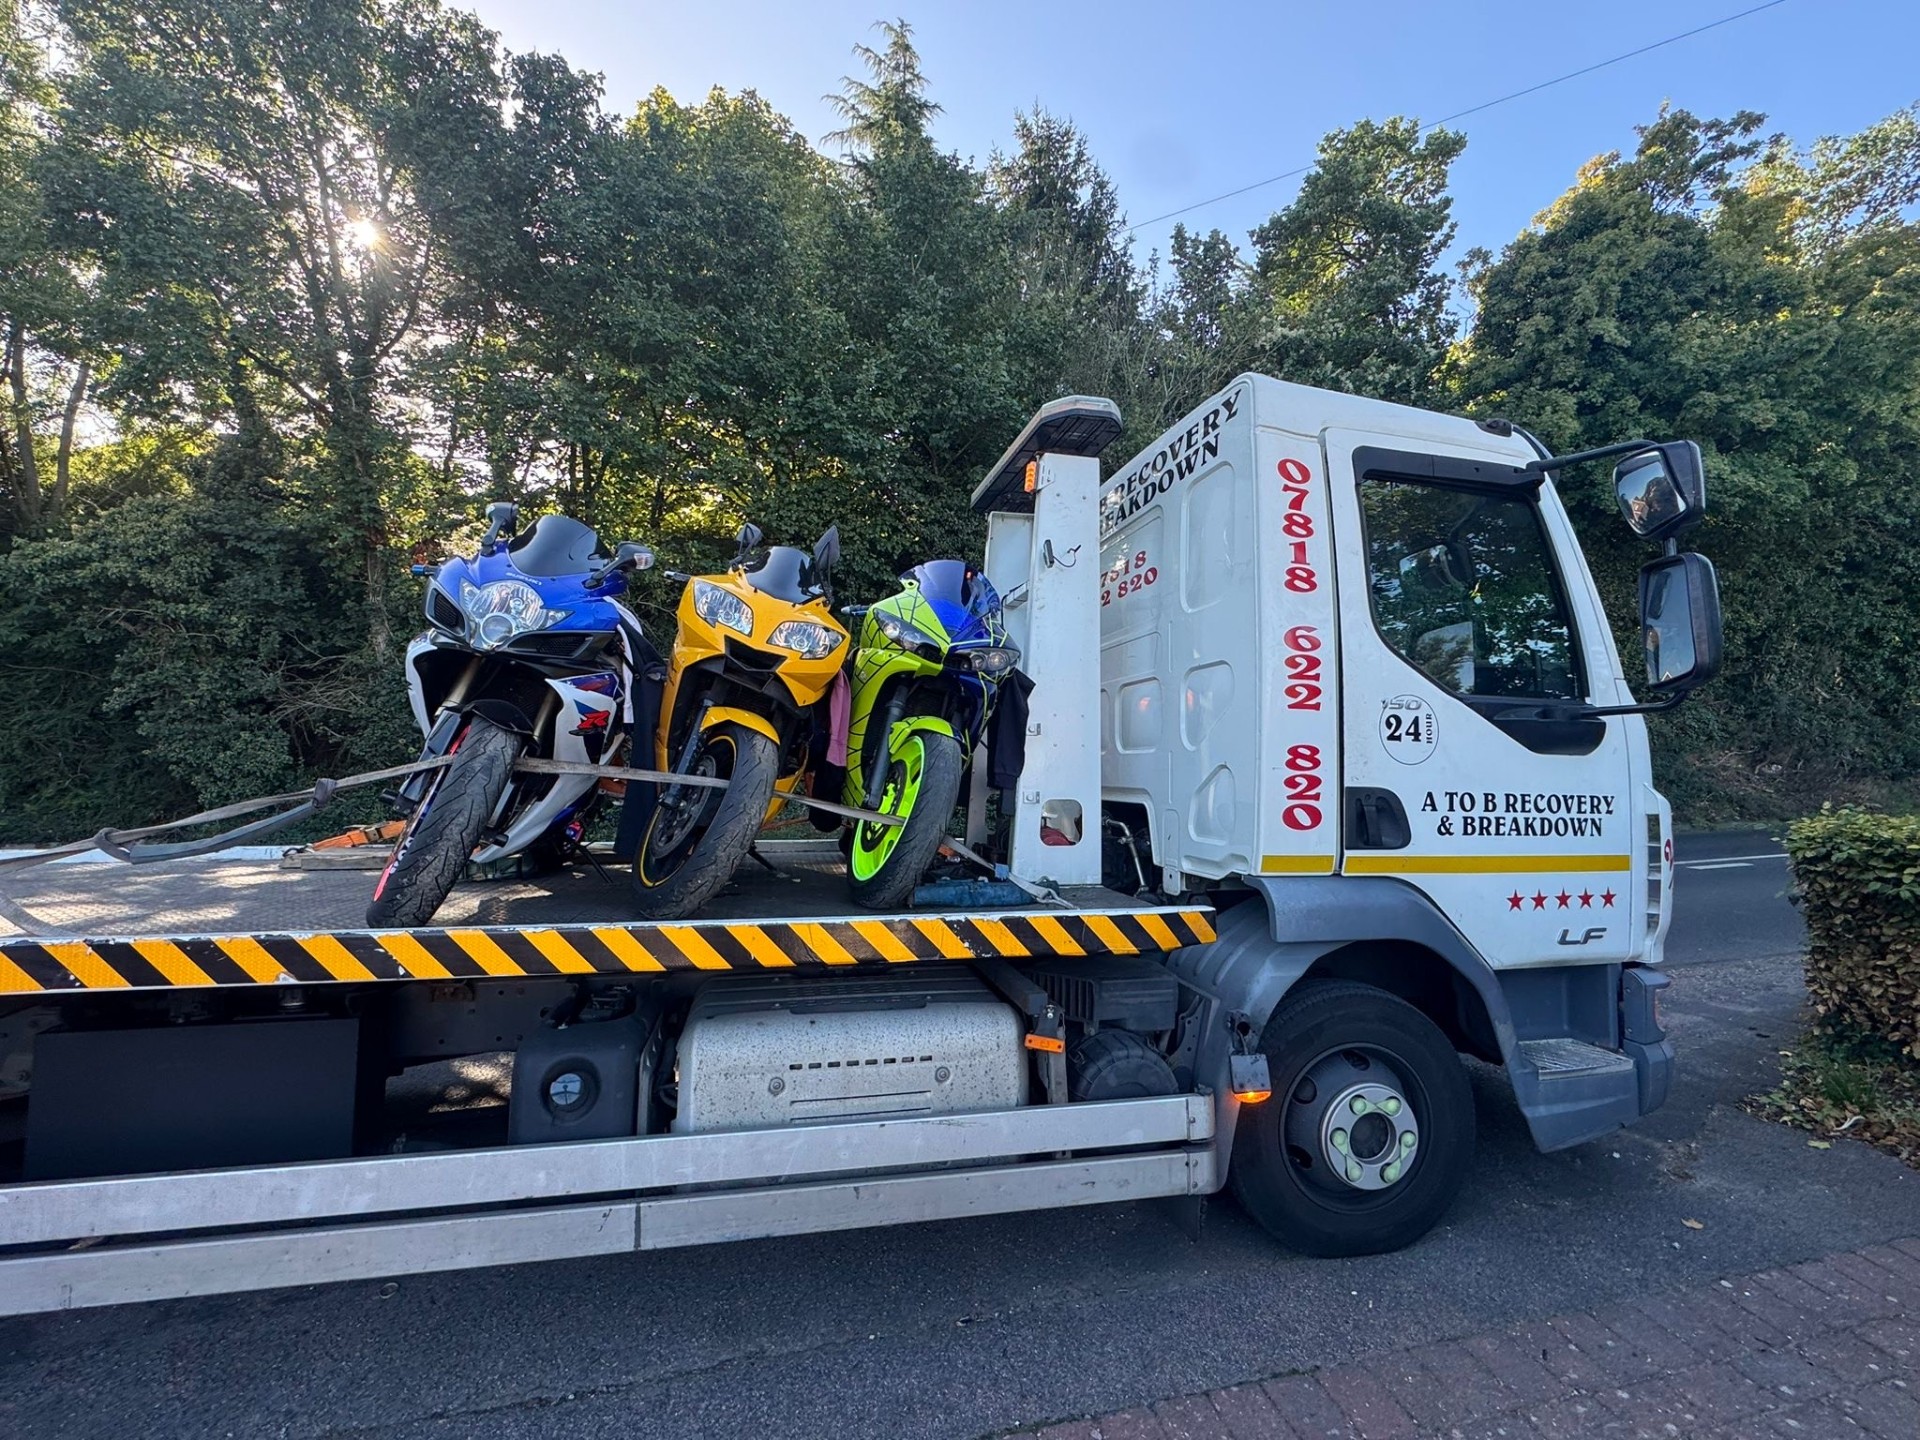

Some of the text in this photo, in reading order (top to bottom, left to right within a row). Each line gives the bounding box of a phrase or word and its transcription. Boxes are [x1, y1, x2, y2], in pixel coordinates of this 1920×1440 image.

[1112, 389, 1242, 502] RECOVERY
[1100, 433, 1220, 536] EAKDOWN
[1101, 550, 1147, 588] 7818
[1118, 567, 1158, 598] 820
[1277, 458, 1322, 831] 07818 622 820
[1385, 713, 1422, 742] 24
[1425, 713, 1433, 744] HOUR
[1421, 791, 1615, 815] A TO B RECOVERY
[1437, 815, 1602, 836] & BREAKDOWN
[1557, 927, 1607, 945] LF
